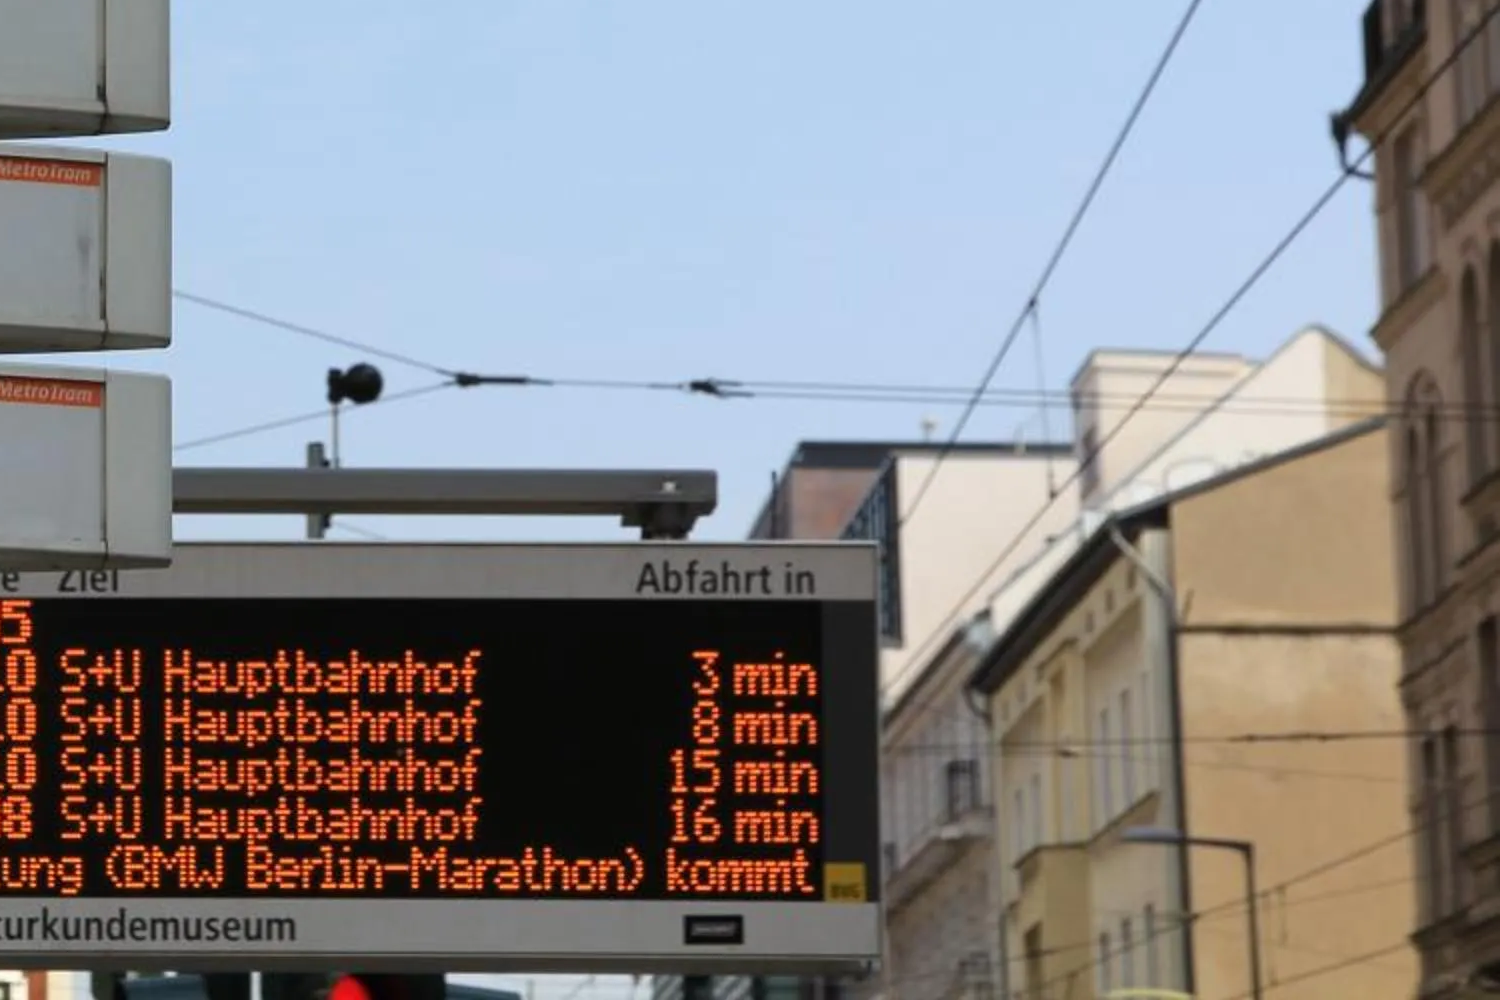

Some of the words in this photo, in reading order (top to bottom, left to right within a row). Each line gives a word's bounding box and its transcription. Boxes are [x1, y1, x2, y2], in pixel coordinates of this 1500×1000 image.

[56, 570, 119, 592] Ziel
[635, 560, 772, 596] Abfahrt
[784, 562, 815, 595] in
[60, 649, 141, 693] S+U
[164, 649, 481, 701] Hauptbahnhof
[692, 652, 720, 696] 3
[733, 651, 817, 696] min
[60, 698, 141, 742] S+U
[164, 698, 481, 750] Hauptbahnhof
[692, 701, 720, 745] 8
[733, 700, 817, 745] min
[60, 747, 141, 791] S+U
[164, 747, 482, 799] Hauptbahnhof
[670, 750, 721, 794] 15
[734, 749, 818, 794] min
[60, 796, 141, 840] S+U
[164, 796, 483, 848] Hauptbahnhof
[671, 799, 721, 843] 16
[734, 798, 819, 843] min
[105, 845, 224, 889] (BMW
[246, 846, 644, 892] Berlin-Marathon)
[666, 847, 814, 893] kommt
